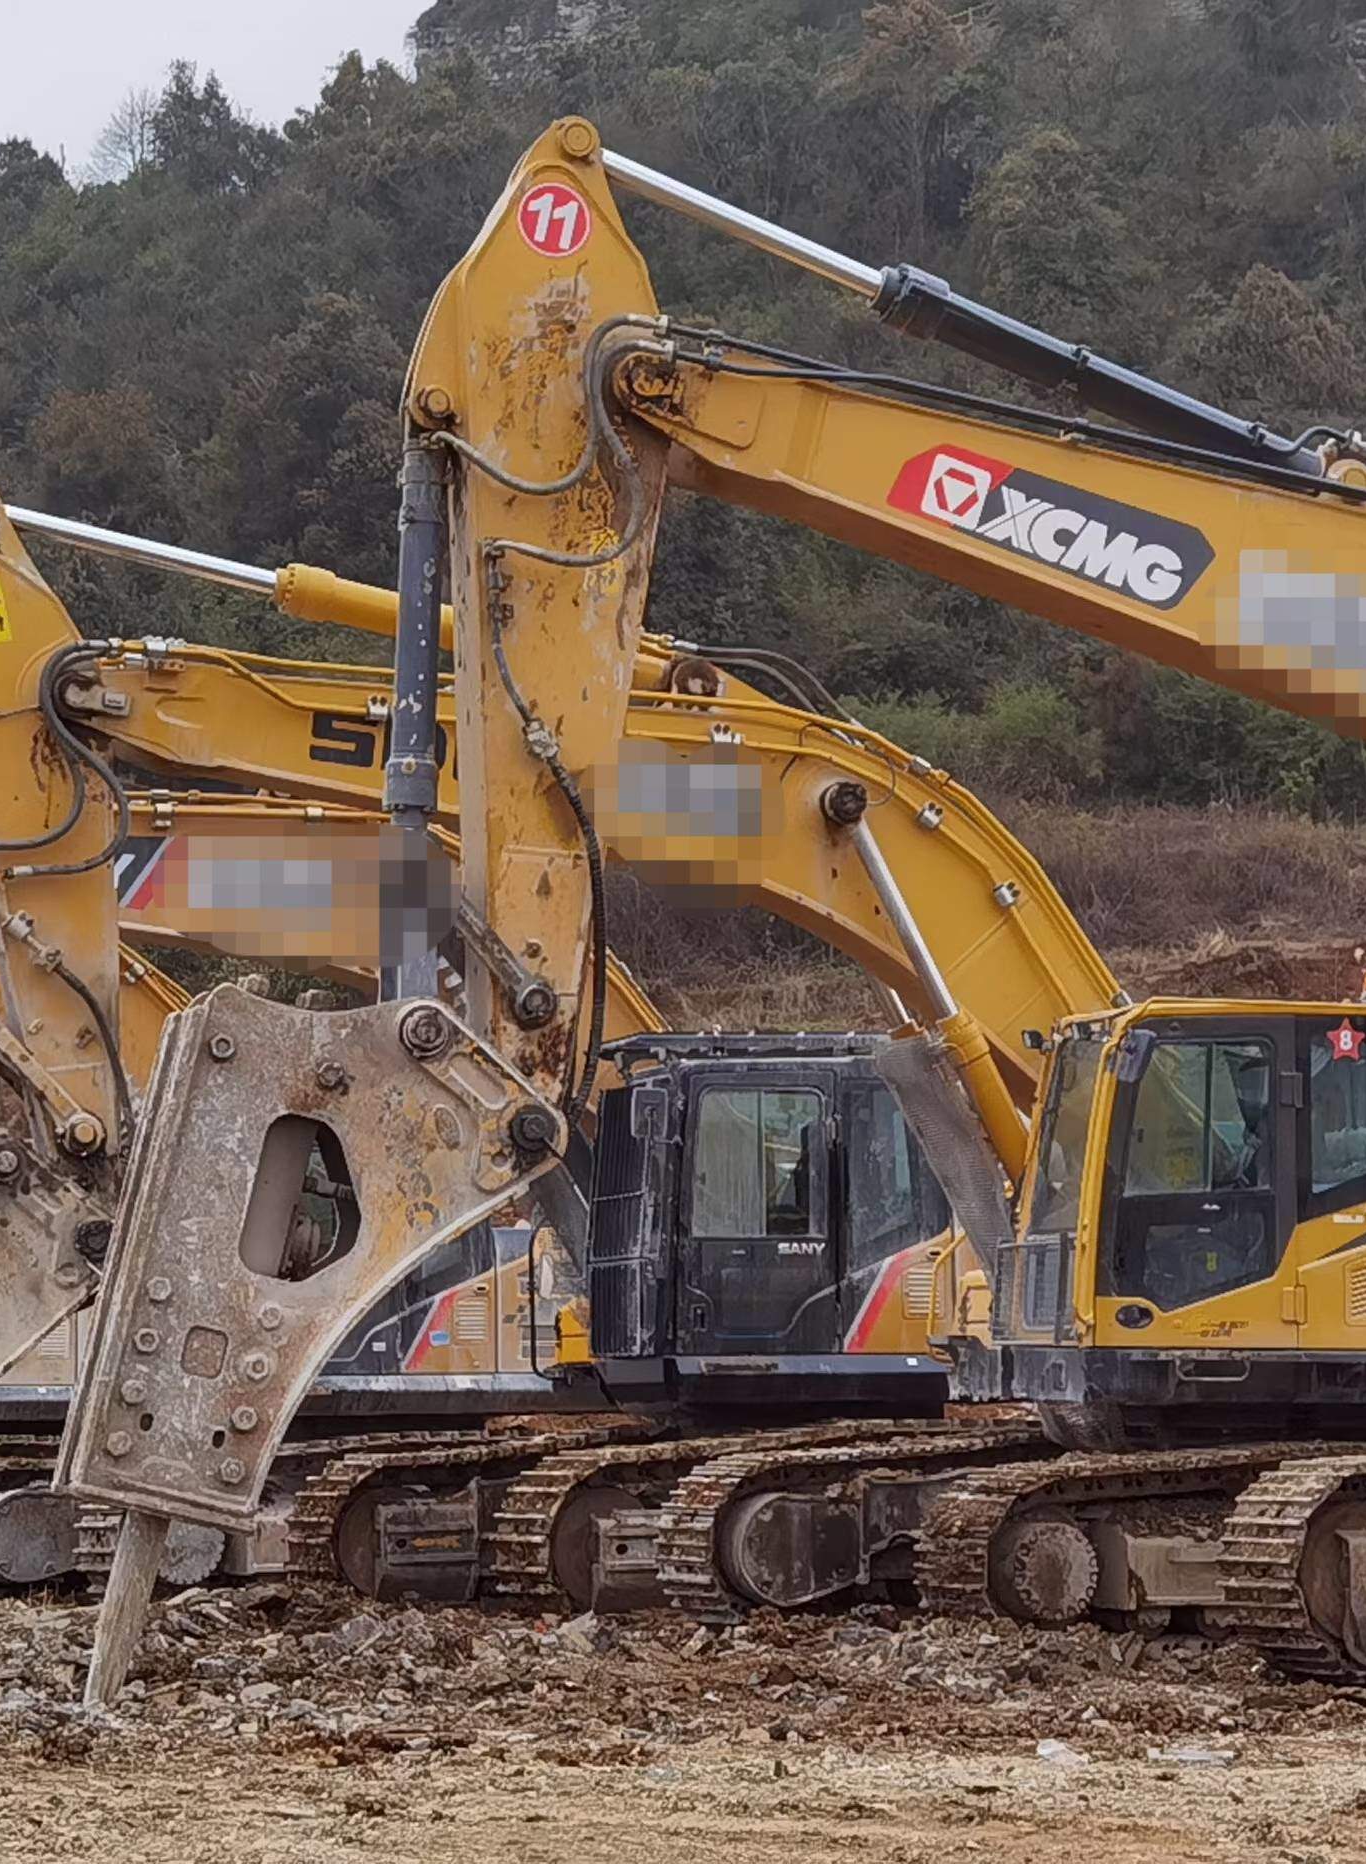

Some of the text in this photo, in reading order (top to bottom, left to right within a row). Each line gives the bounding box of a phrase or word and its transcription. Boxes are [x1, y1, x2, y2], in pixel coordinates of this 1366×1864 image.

[527, 193, 579, 250] 11
[975, 485, 1182, 601] XCMG
[1339, 1030, 1353, 1051] 8
[777, 1242, 826, 1255] SANY
